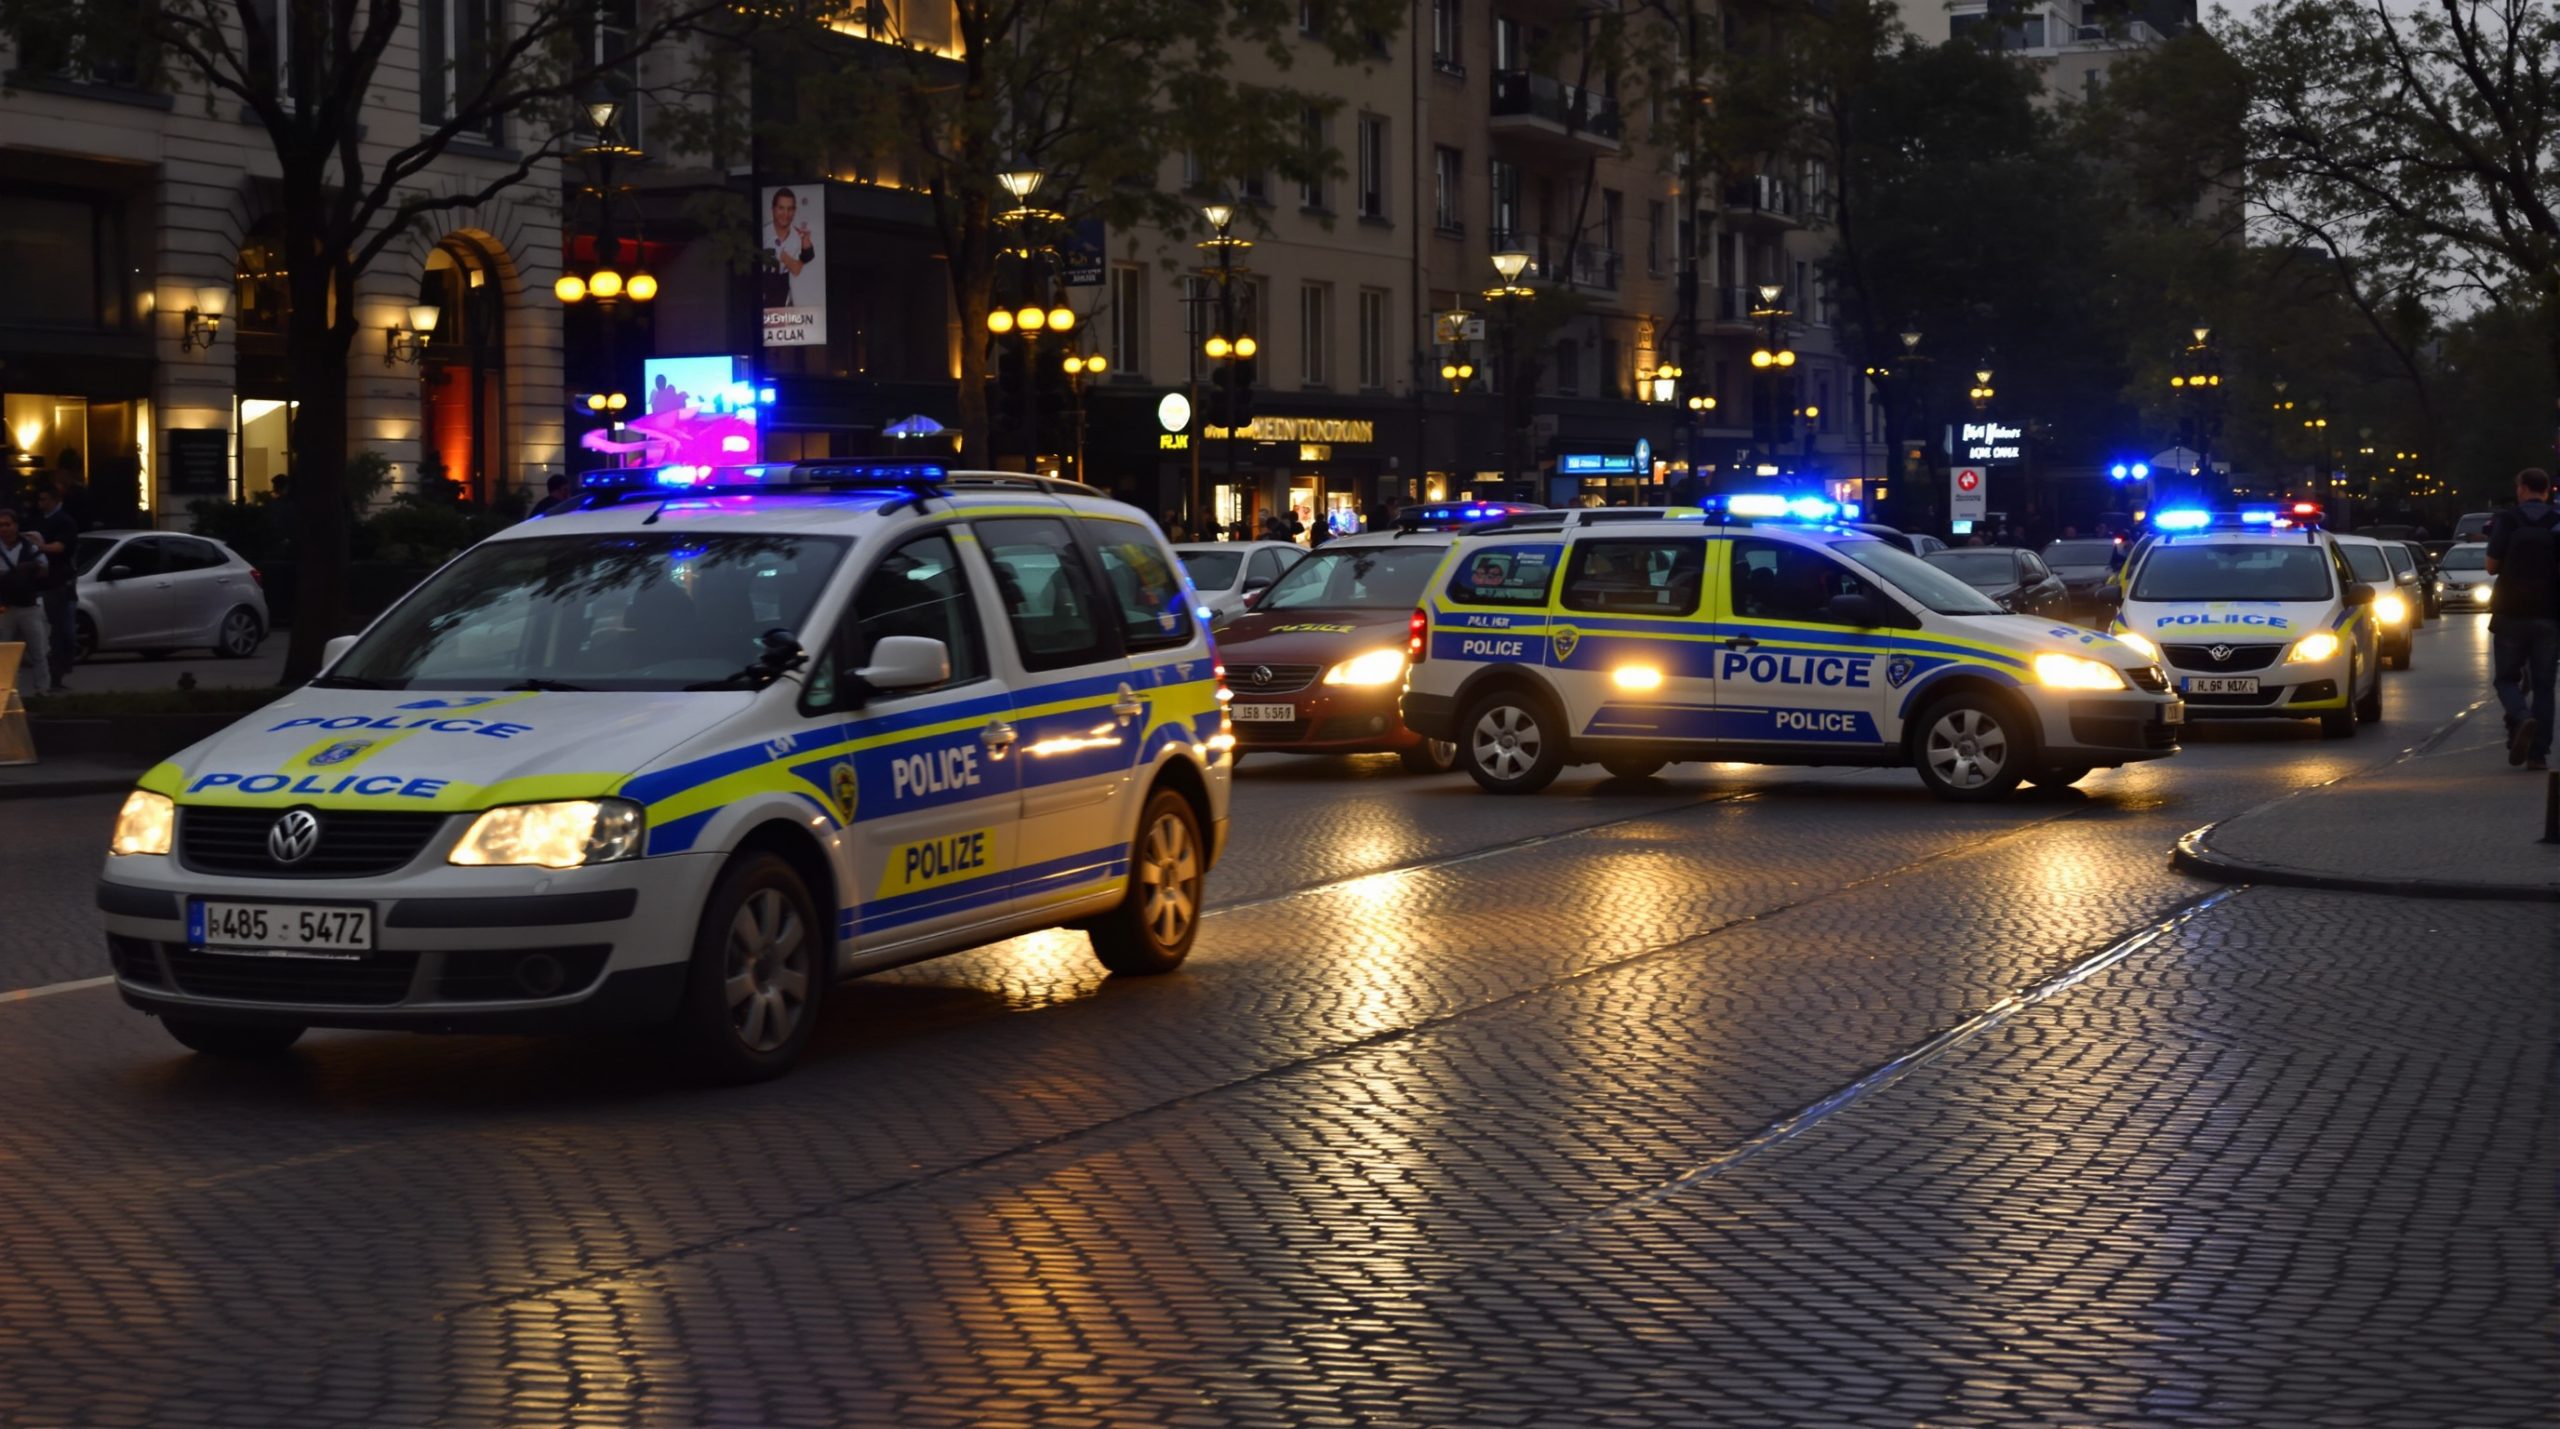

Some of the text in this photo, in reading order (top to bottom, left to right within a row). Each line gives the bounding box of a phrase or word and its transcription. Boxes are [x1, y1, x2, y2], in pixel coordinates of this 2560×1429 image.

[1462, 640, 1523, 656] POLICE
[1722, 652, 1873, 688] POLICE
[266, 716, 535, 739] POLICE
[1776, 711, 1856, 732] POLICE
[891, 744, 981, 800] POLICE
[187, 773, 451, 799] POLICE
[905, 832, 985, 884] POLIZE
